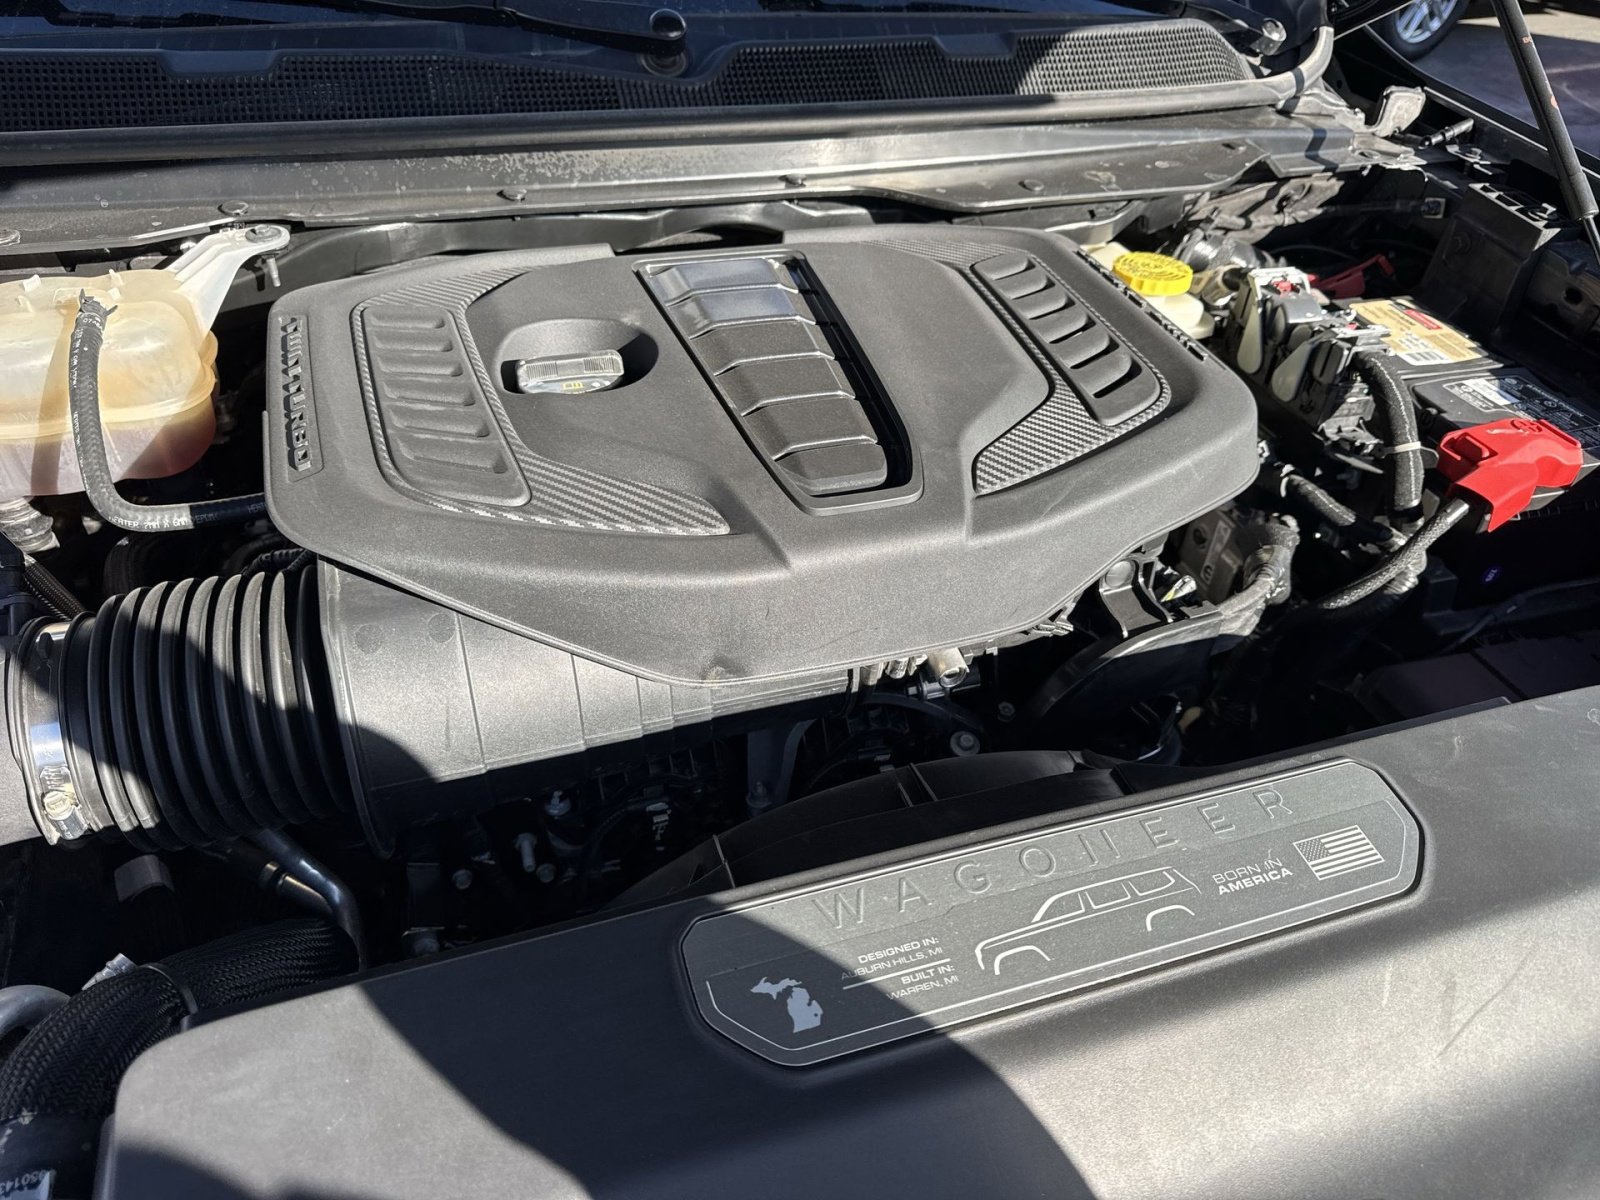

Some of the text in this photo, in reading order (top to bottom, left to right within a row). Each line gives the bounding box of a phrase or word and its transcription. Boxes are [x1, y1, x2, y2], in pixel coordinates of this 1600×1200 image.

[283, 317, 311, 472] TWIN TURBO
[1212, 857, 1283, 884] BORN IN
[1218, 867, 1294, 895] AMERICA
[841, 947, 943, 980] AUBURN HILLS, MI
[858, 937, 940, 964] DESIGNED IN:
[887, 975, 959, 1000] WARREN, MI
[900, 964, 955, 985] BUILT IN:
